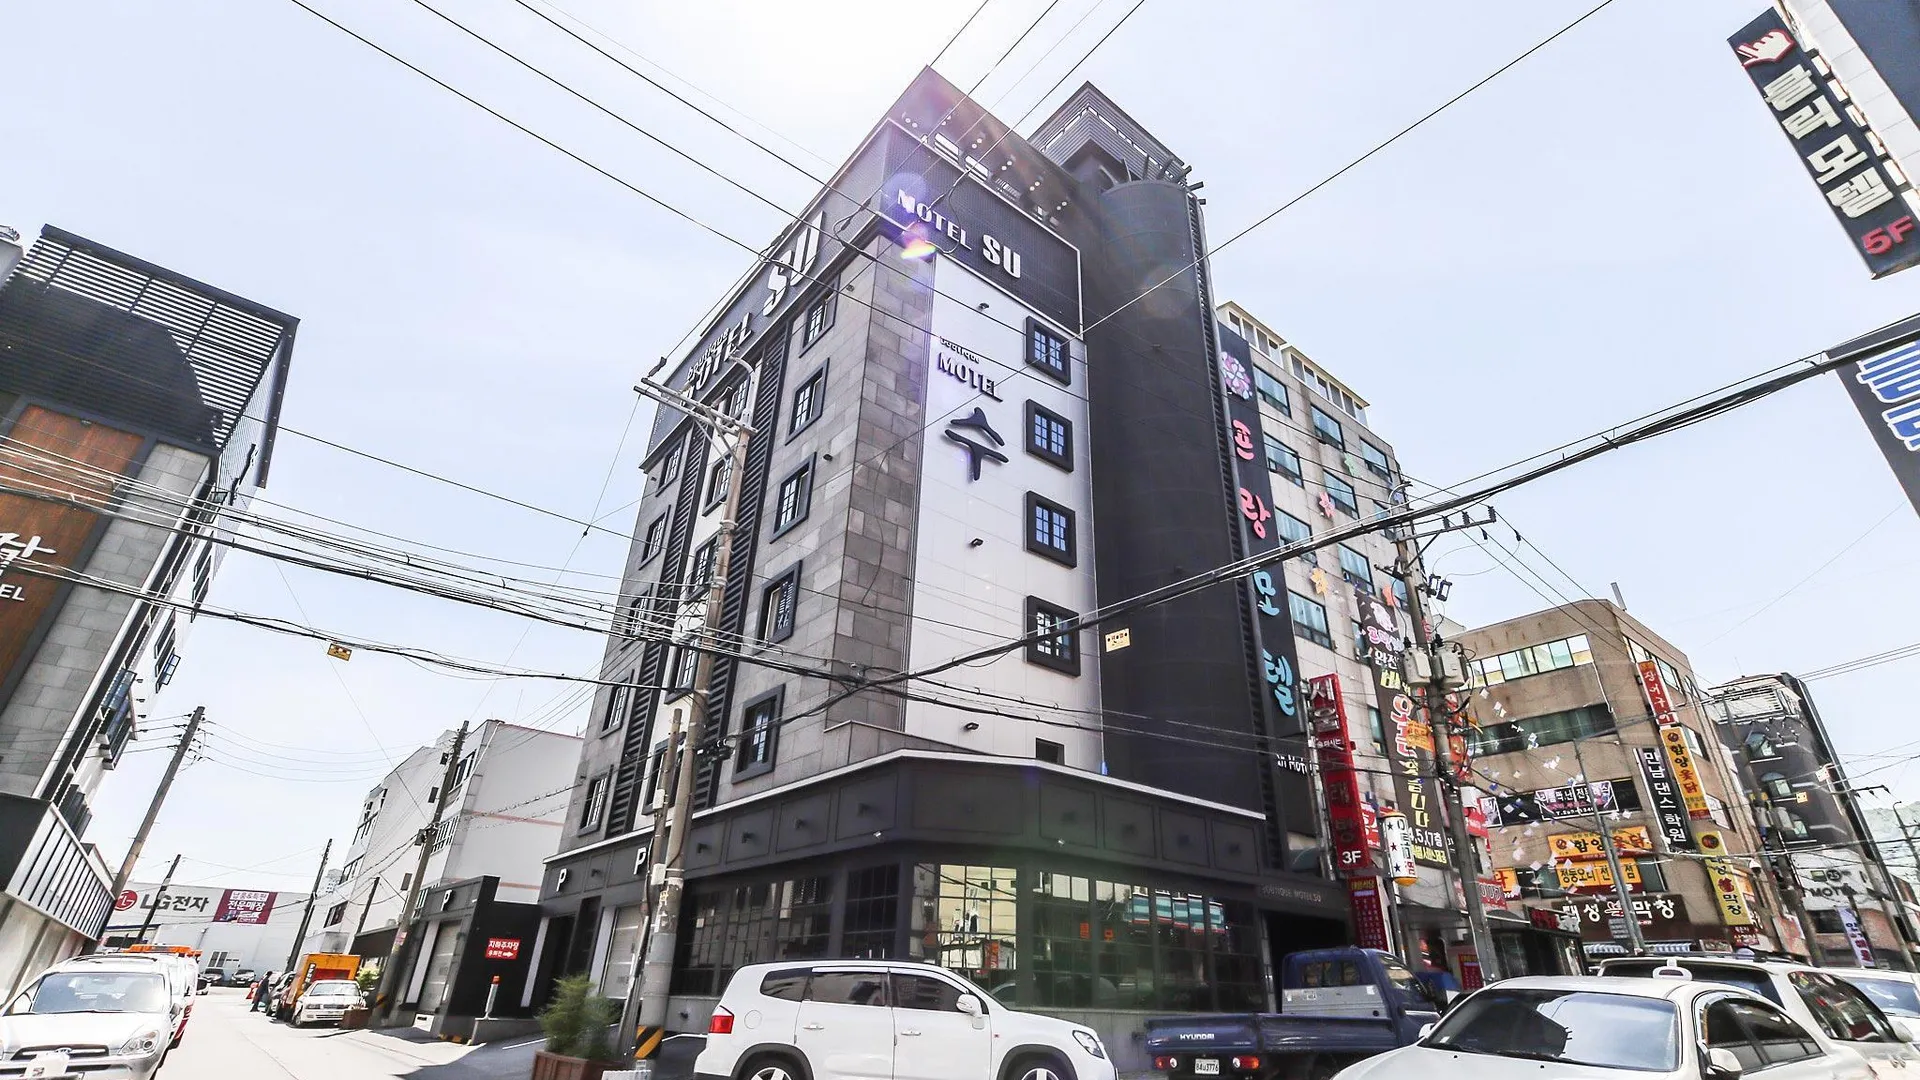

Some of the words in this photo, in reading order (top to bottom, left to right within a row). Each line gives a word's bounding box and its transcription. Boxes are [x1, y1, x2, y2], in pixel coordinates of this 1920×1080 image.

[897, 188, 972, 251] MOTEL
[981, 233, 1022, 279] SU
[1860, 215, 1915, 255] 5F
[762, 211, 825, 317] SU
[936, 351, 1004, 404] MOTEL
[943, 405, 1010, 482] 수
[633, 847, 647, 875] P
[1342, 850, 1362, 865] 3F
[556, 868, 567, 892] P
[139, 892, 210, 914] LG전자
[441, 888, 453, 911] P
